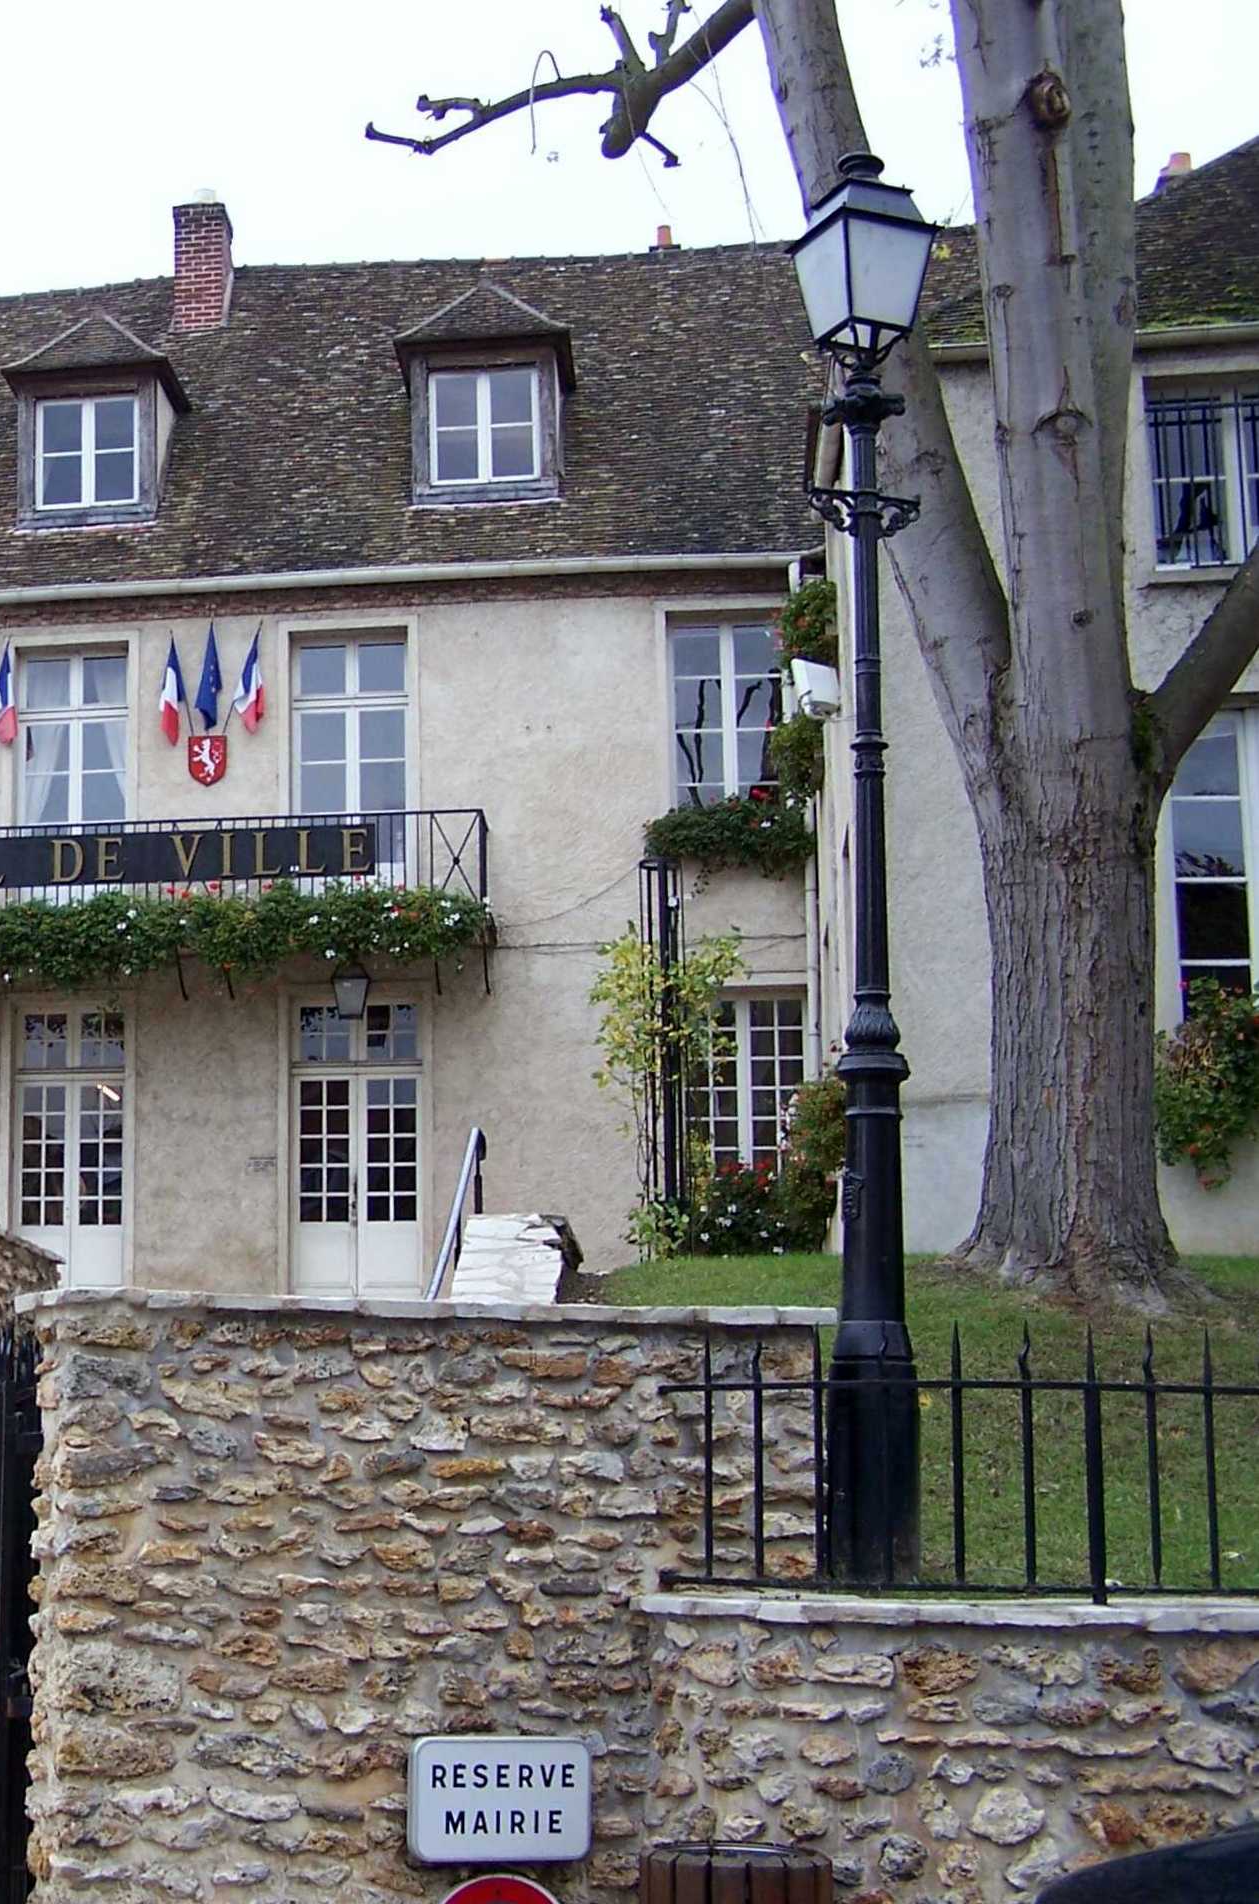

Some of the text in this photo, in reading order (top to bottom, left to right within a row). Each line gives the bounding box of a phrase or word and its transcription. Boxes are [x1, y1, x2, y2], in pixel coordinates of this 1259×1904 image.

[49, 836, 126, 883] DE
[169, 828, 371, 878] VILLE
[445, 1810, 563, 1834] MAIRIE
